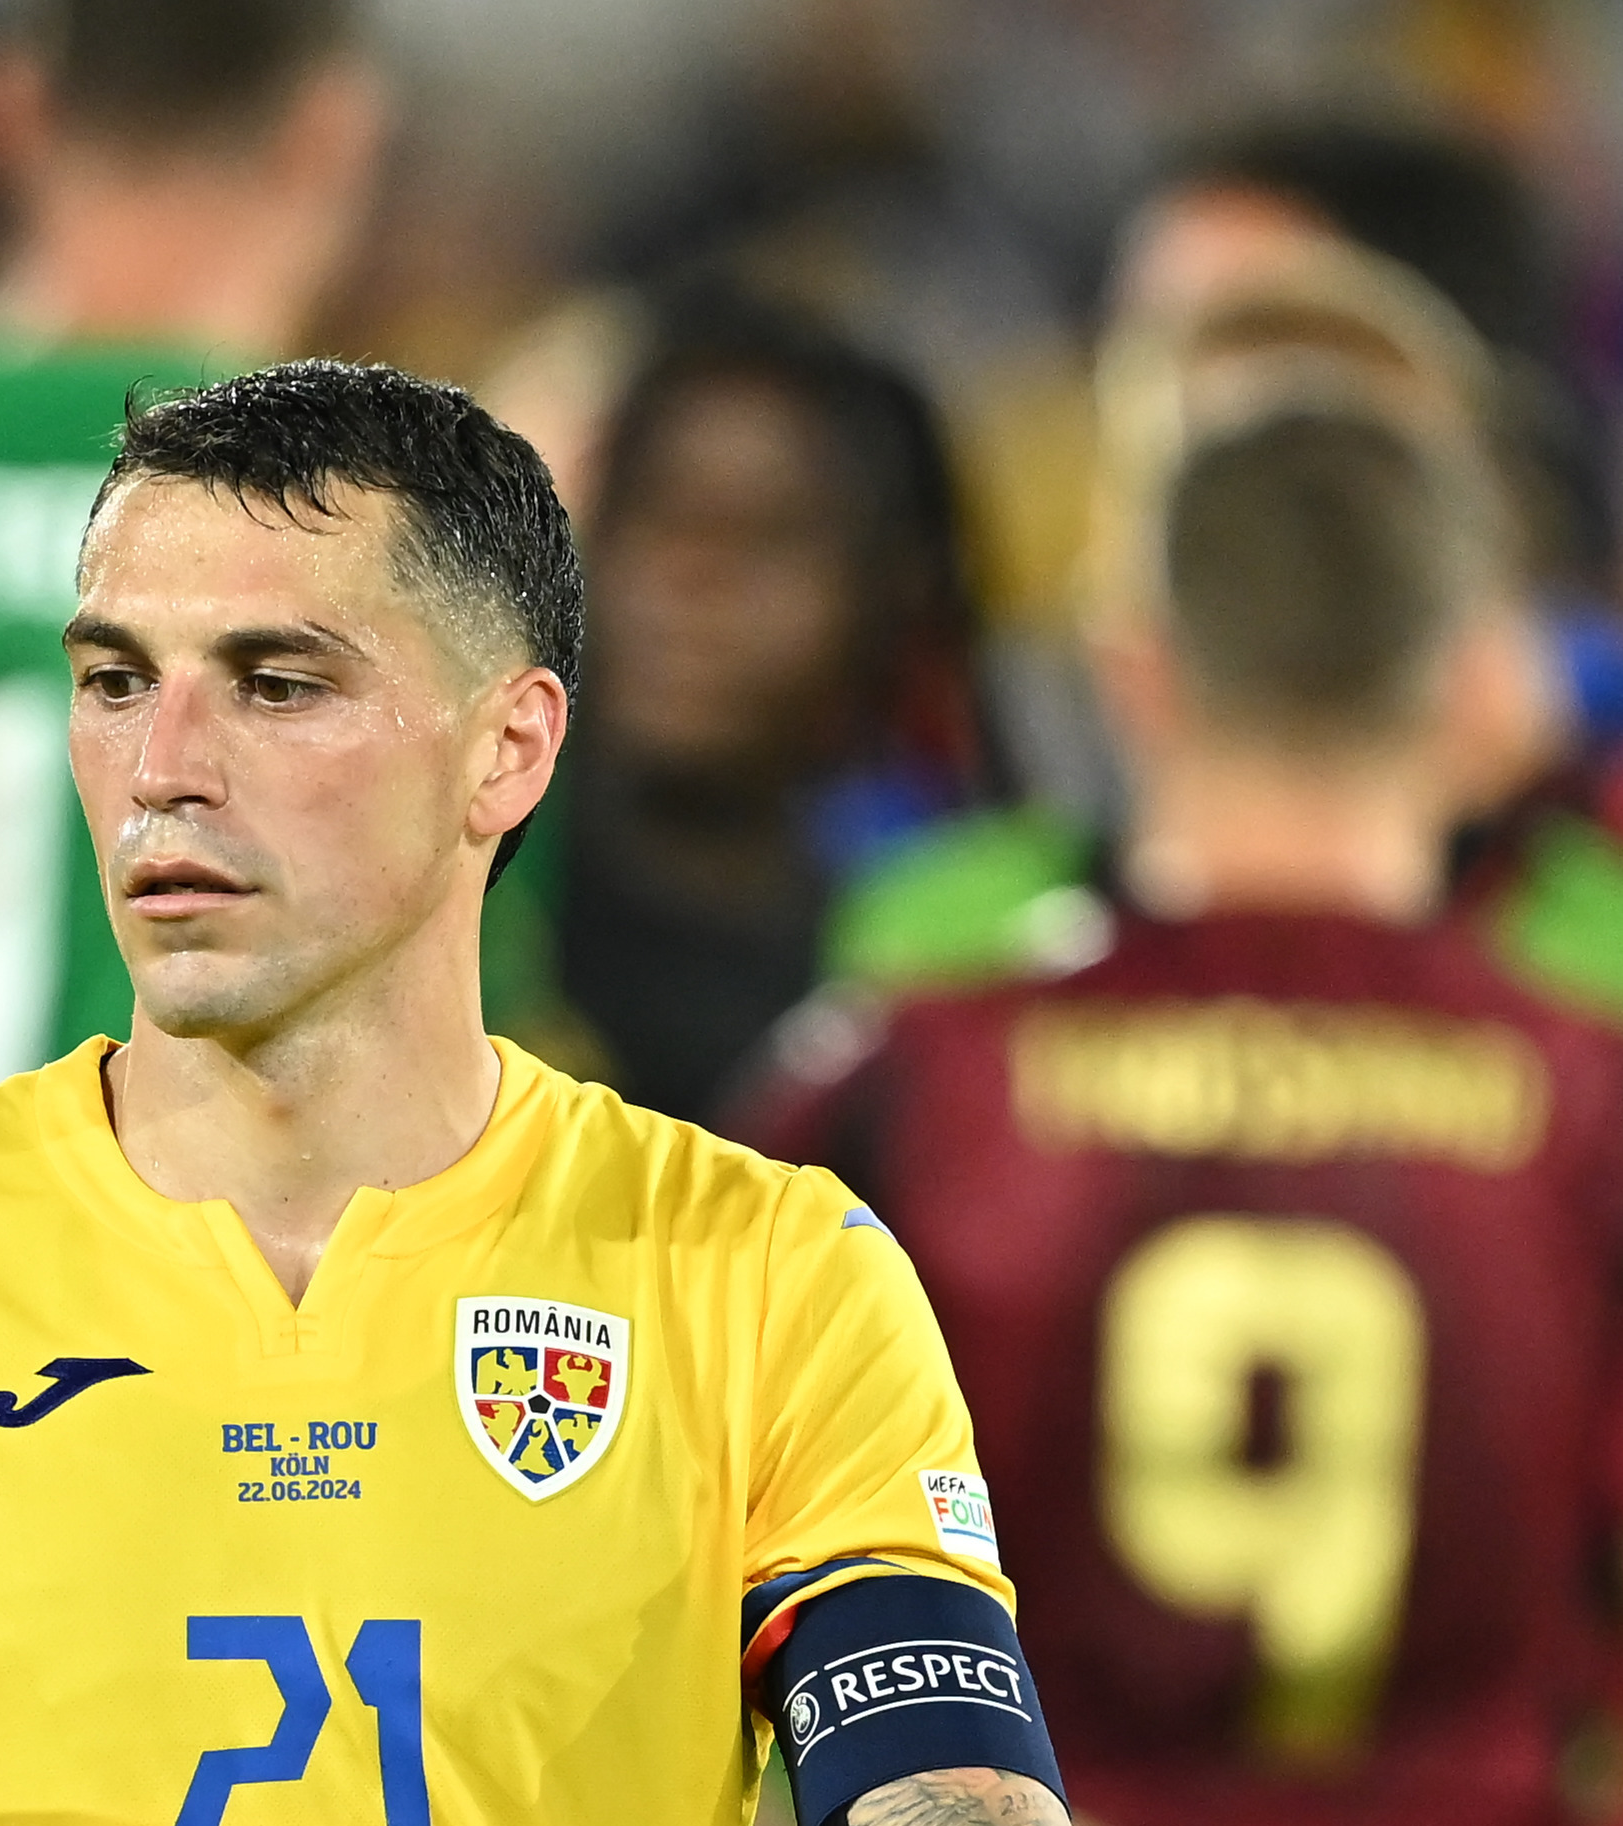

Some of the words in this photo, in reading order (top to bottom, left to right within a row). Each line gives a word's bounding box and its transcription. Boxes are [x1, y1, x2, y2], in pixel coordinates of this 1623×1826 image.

[473, 1306, 611, 1349] ROMÂNIA
[222, 1423, 282, 1452] BEL
[308, 1421, 377, 1450] ROU
[270, 1453, 329, 1476] KÖLN
[1095, 1213, 1429, 1745] 9
[238, 1479, 361, 1502] 22.06.2024
[928, 1475, 966, 1494] UEFA
[830, 1653, 1022, 1711] RESPECT
